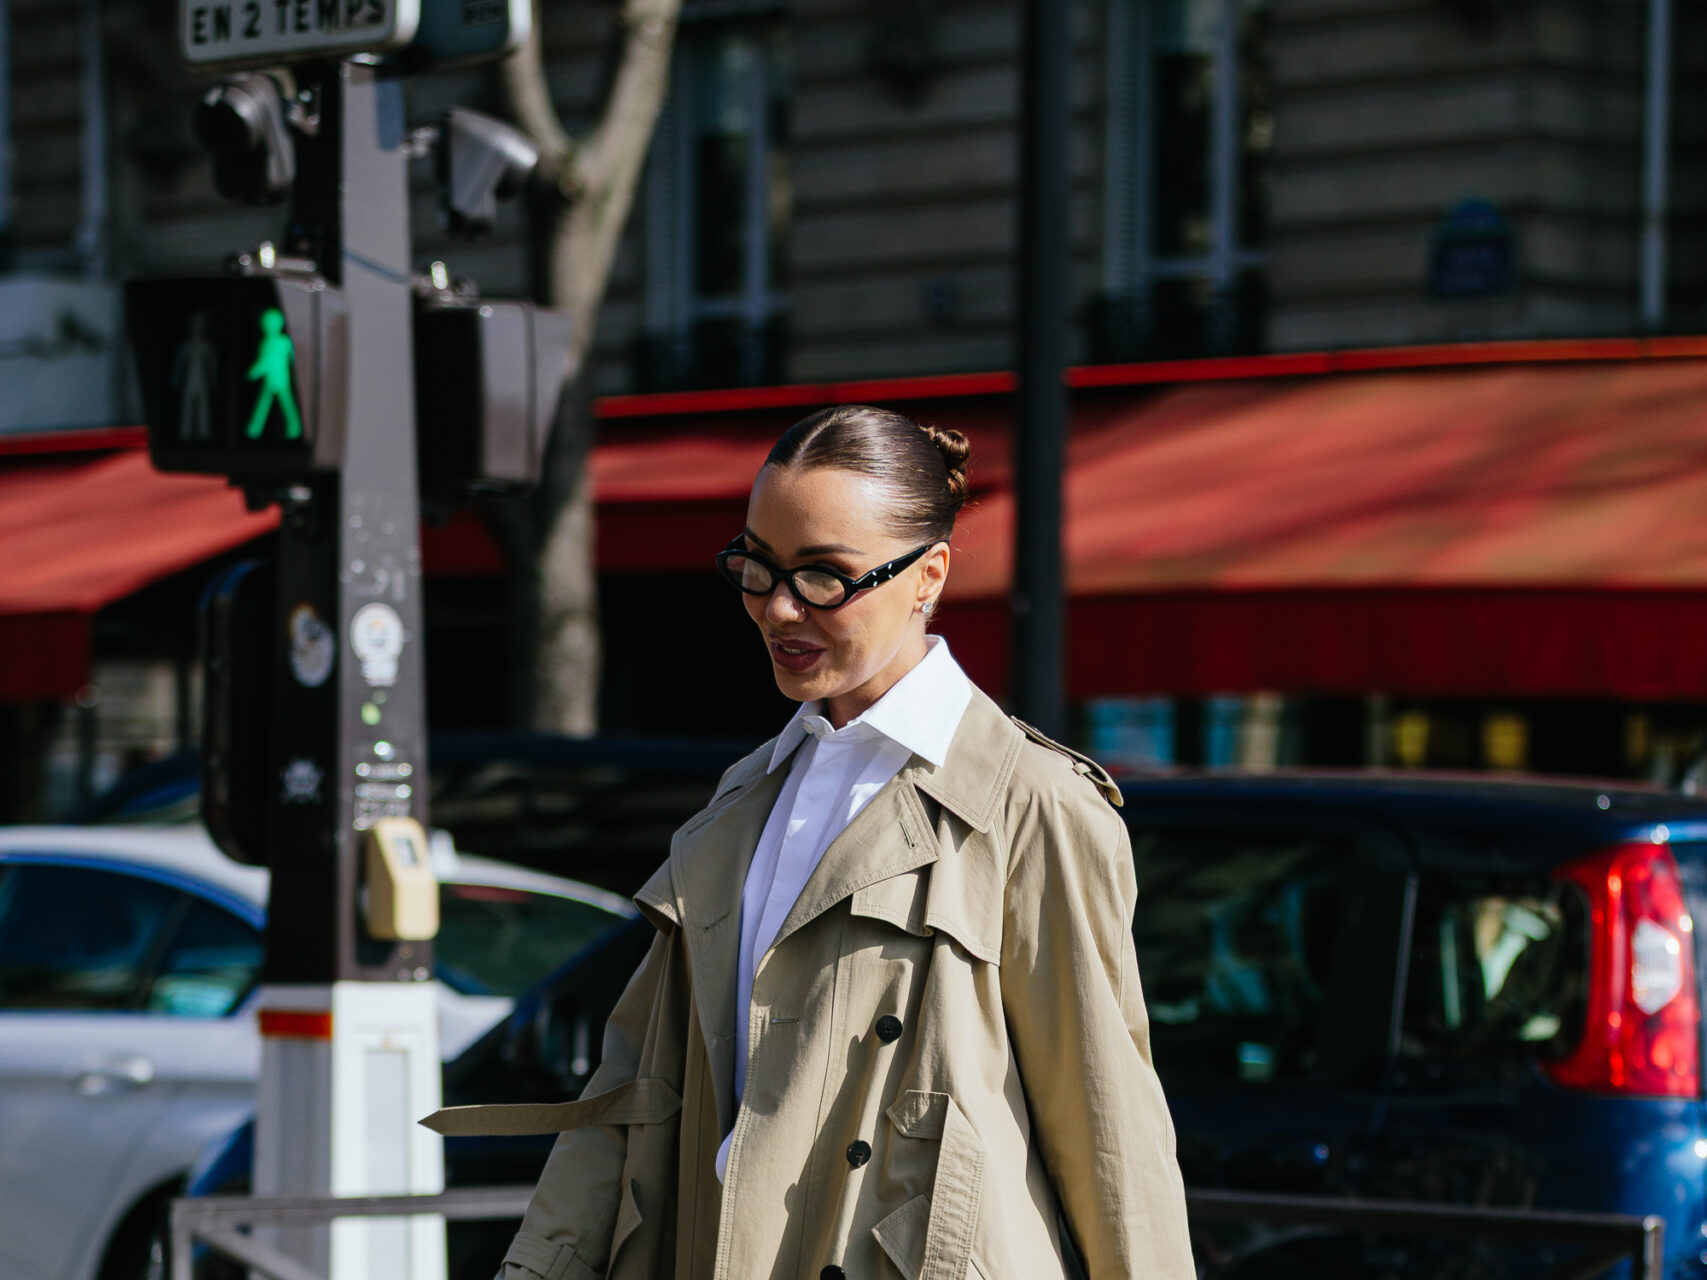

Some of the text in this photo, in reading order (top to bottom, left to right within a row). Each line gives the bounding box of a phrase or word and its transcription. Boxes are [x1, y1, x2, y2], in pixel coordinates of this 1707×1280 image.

[192, 0, 386, 45] EN 2 TEMPS
